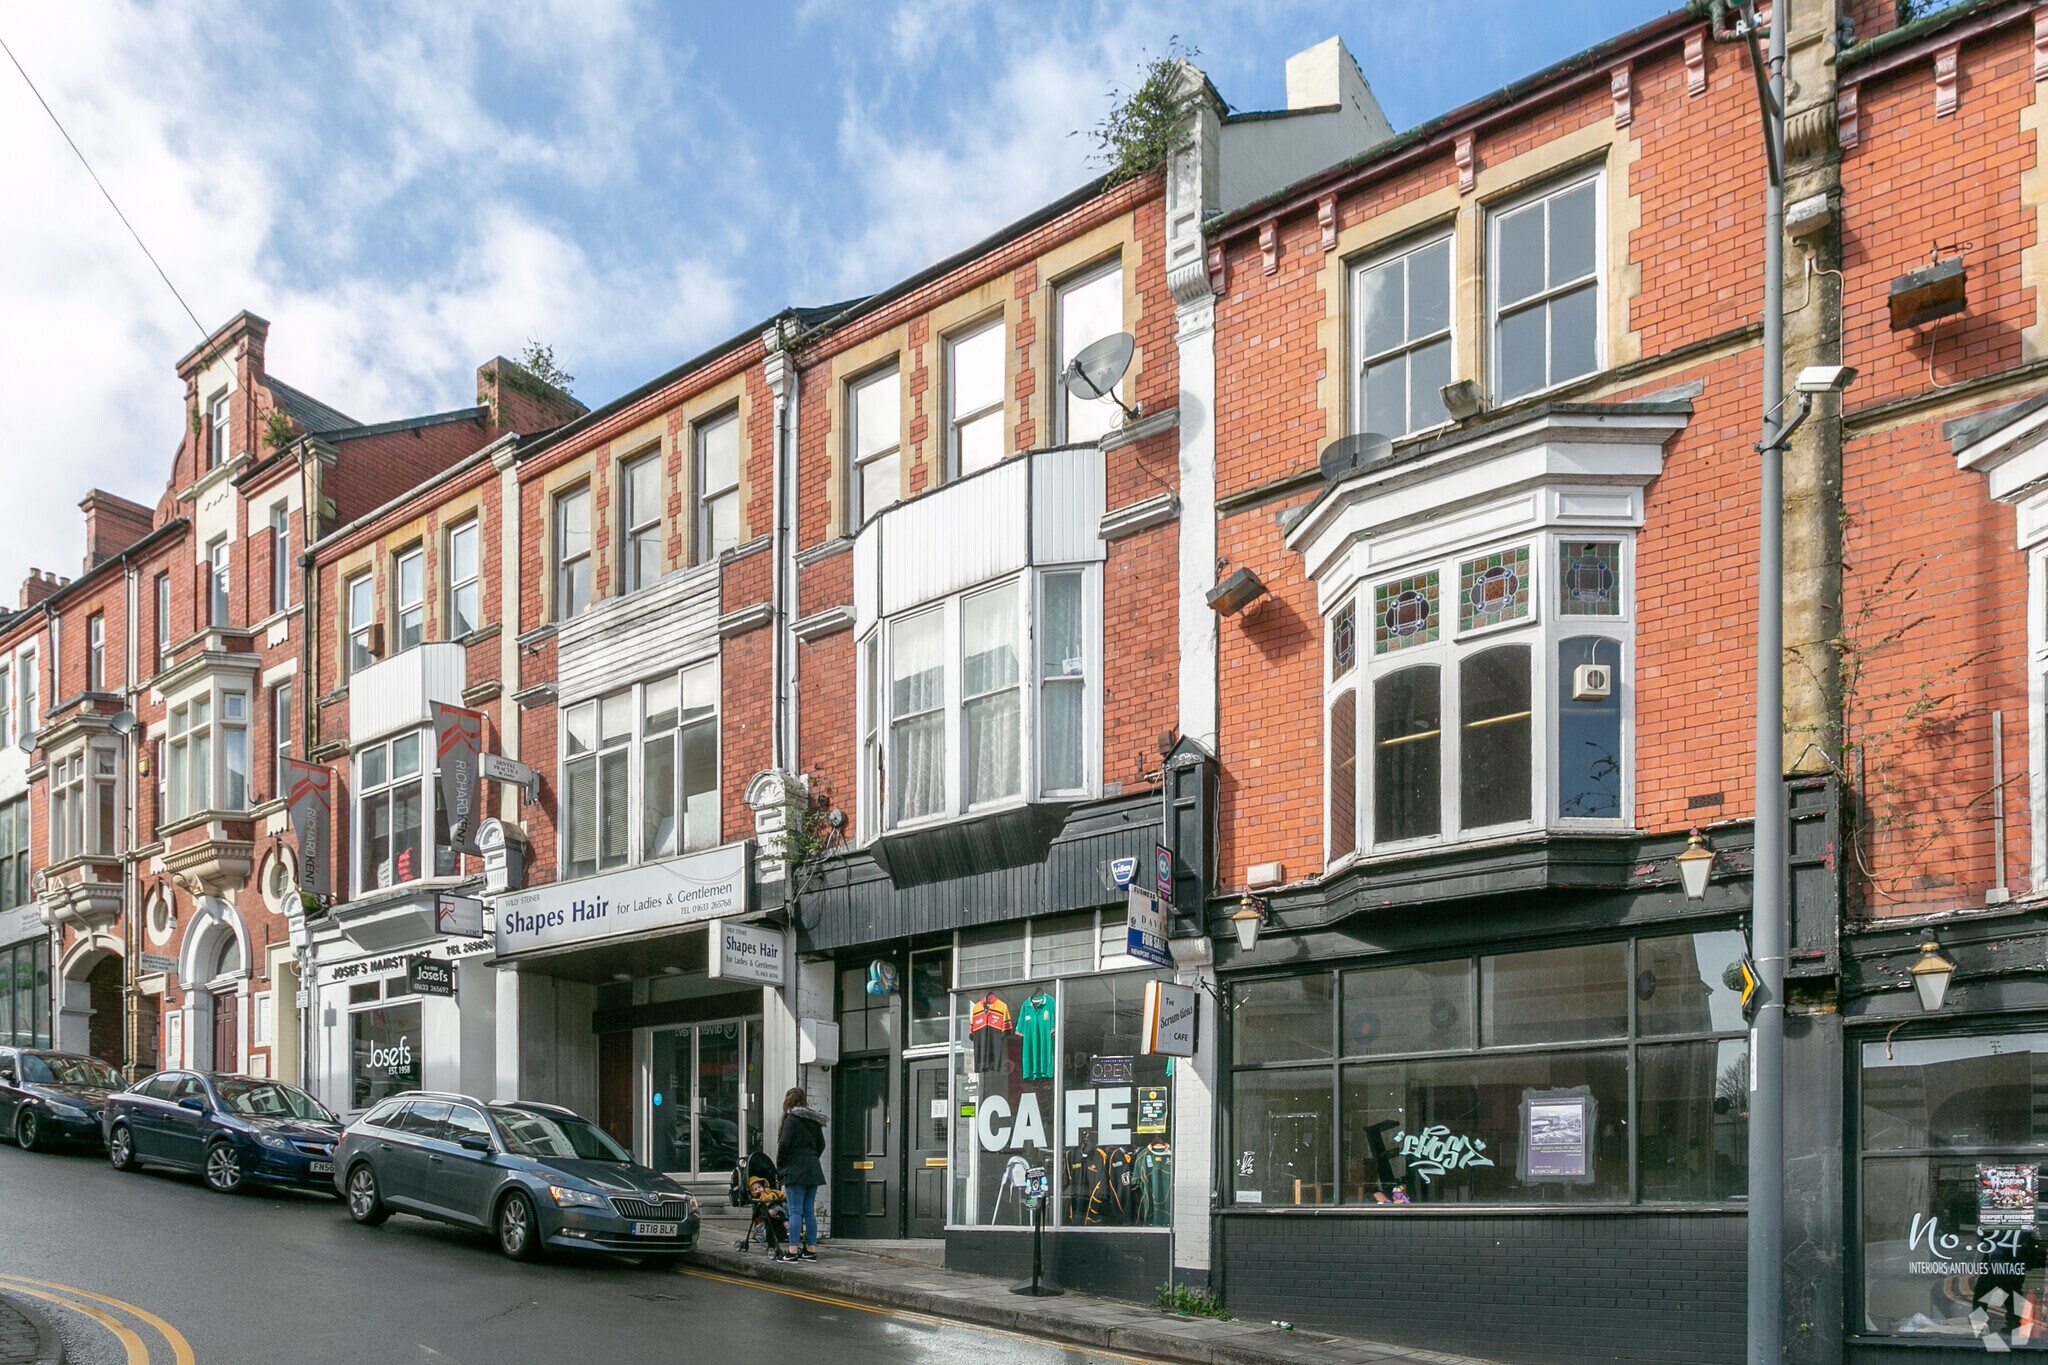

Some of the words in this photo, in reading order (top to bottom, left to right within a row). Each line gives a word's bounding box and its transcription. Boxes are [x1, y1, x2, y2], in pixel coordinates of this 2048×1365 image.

[505, 909, 564, 936] Shapes
[572, 895, 609, 923] Hair
[617, 902, 630, 914] for
[633, 896, 662, 912] Ladies
[666, 892, 674, 905] &
[677, 883, 732, 903] Gentlemen
[681, 906, 690, 915] TEL
[726, 935, 756, 956] Shapes
[760, 942, 778, 958] Hair
[1142, 932, 1153, 947] FOR
[1154, 936, 1166, 952] SALE
[332, 962, 368, 980] JOSEF'S
[416, 966, 449, 982] Josefs
[414, 983, 429, 991] 01633
[1174, 1032, 1189, 1041] CAFE
[366, 1035, 411, 1068] Josefs
[398, 1065, 411, 1074] 1958
[1092, 1063, 1132, 1077] OPEN
[978, 1087, 1131, 1152] CAFE
[639, 1223, 658, 1234] BT18
[660, 1224, 675, 1234] BLK
[1991, 1263, 2025, 1275] VINTAGE
